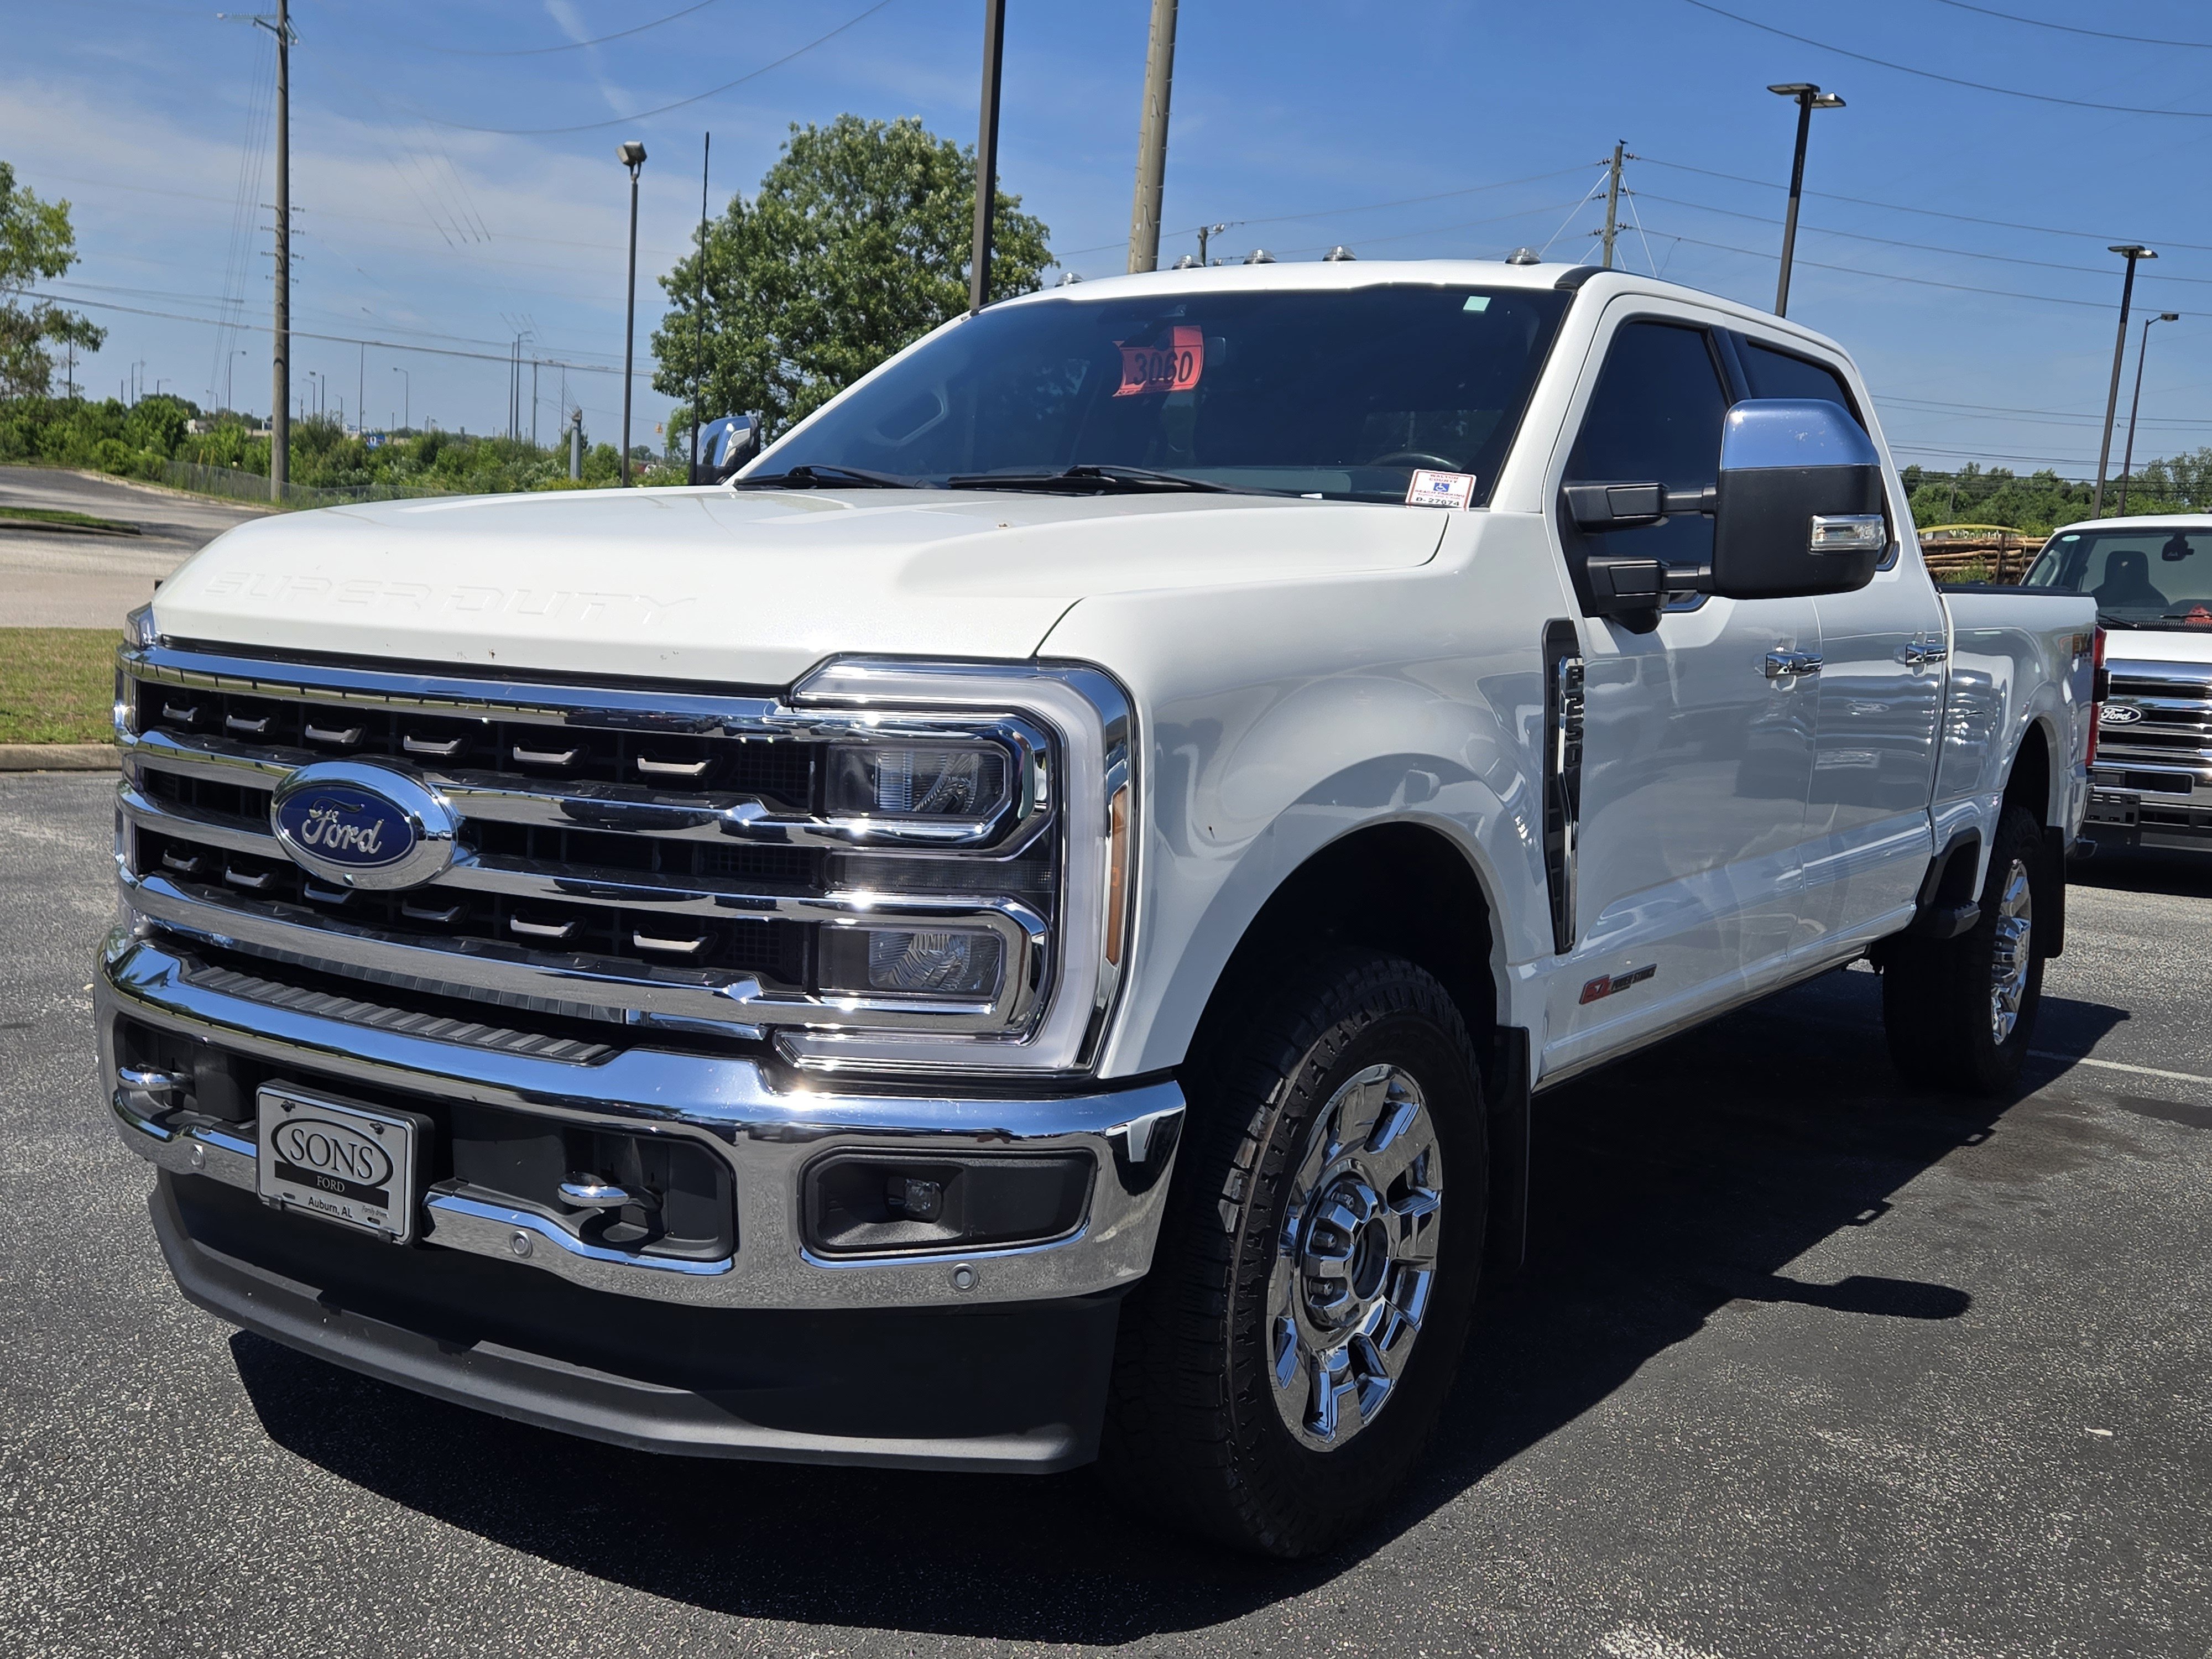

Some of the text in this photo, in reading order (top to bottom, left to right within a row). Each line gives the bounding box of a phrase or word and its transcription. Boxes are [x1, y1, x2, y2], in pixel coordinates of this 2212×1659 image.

[1134, 351, 1193, 385] 3060
[202, 571, 697, 625] SUPER DUTY
[2101, 708, 2132, 720] Ford
[301, 797, 384, 854] Ford
[290, 1128, 373, 1179] SONS
[317, 1175, 345, 1193] FORD
[308, 1196, 353, 1218] Auburn, AL
